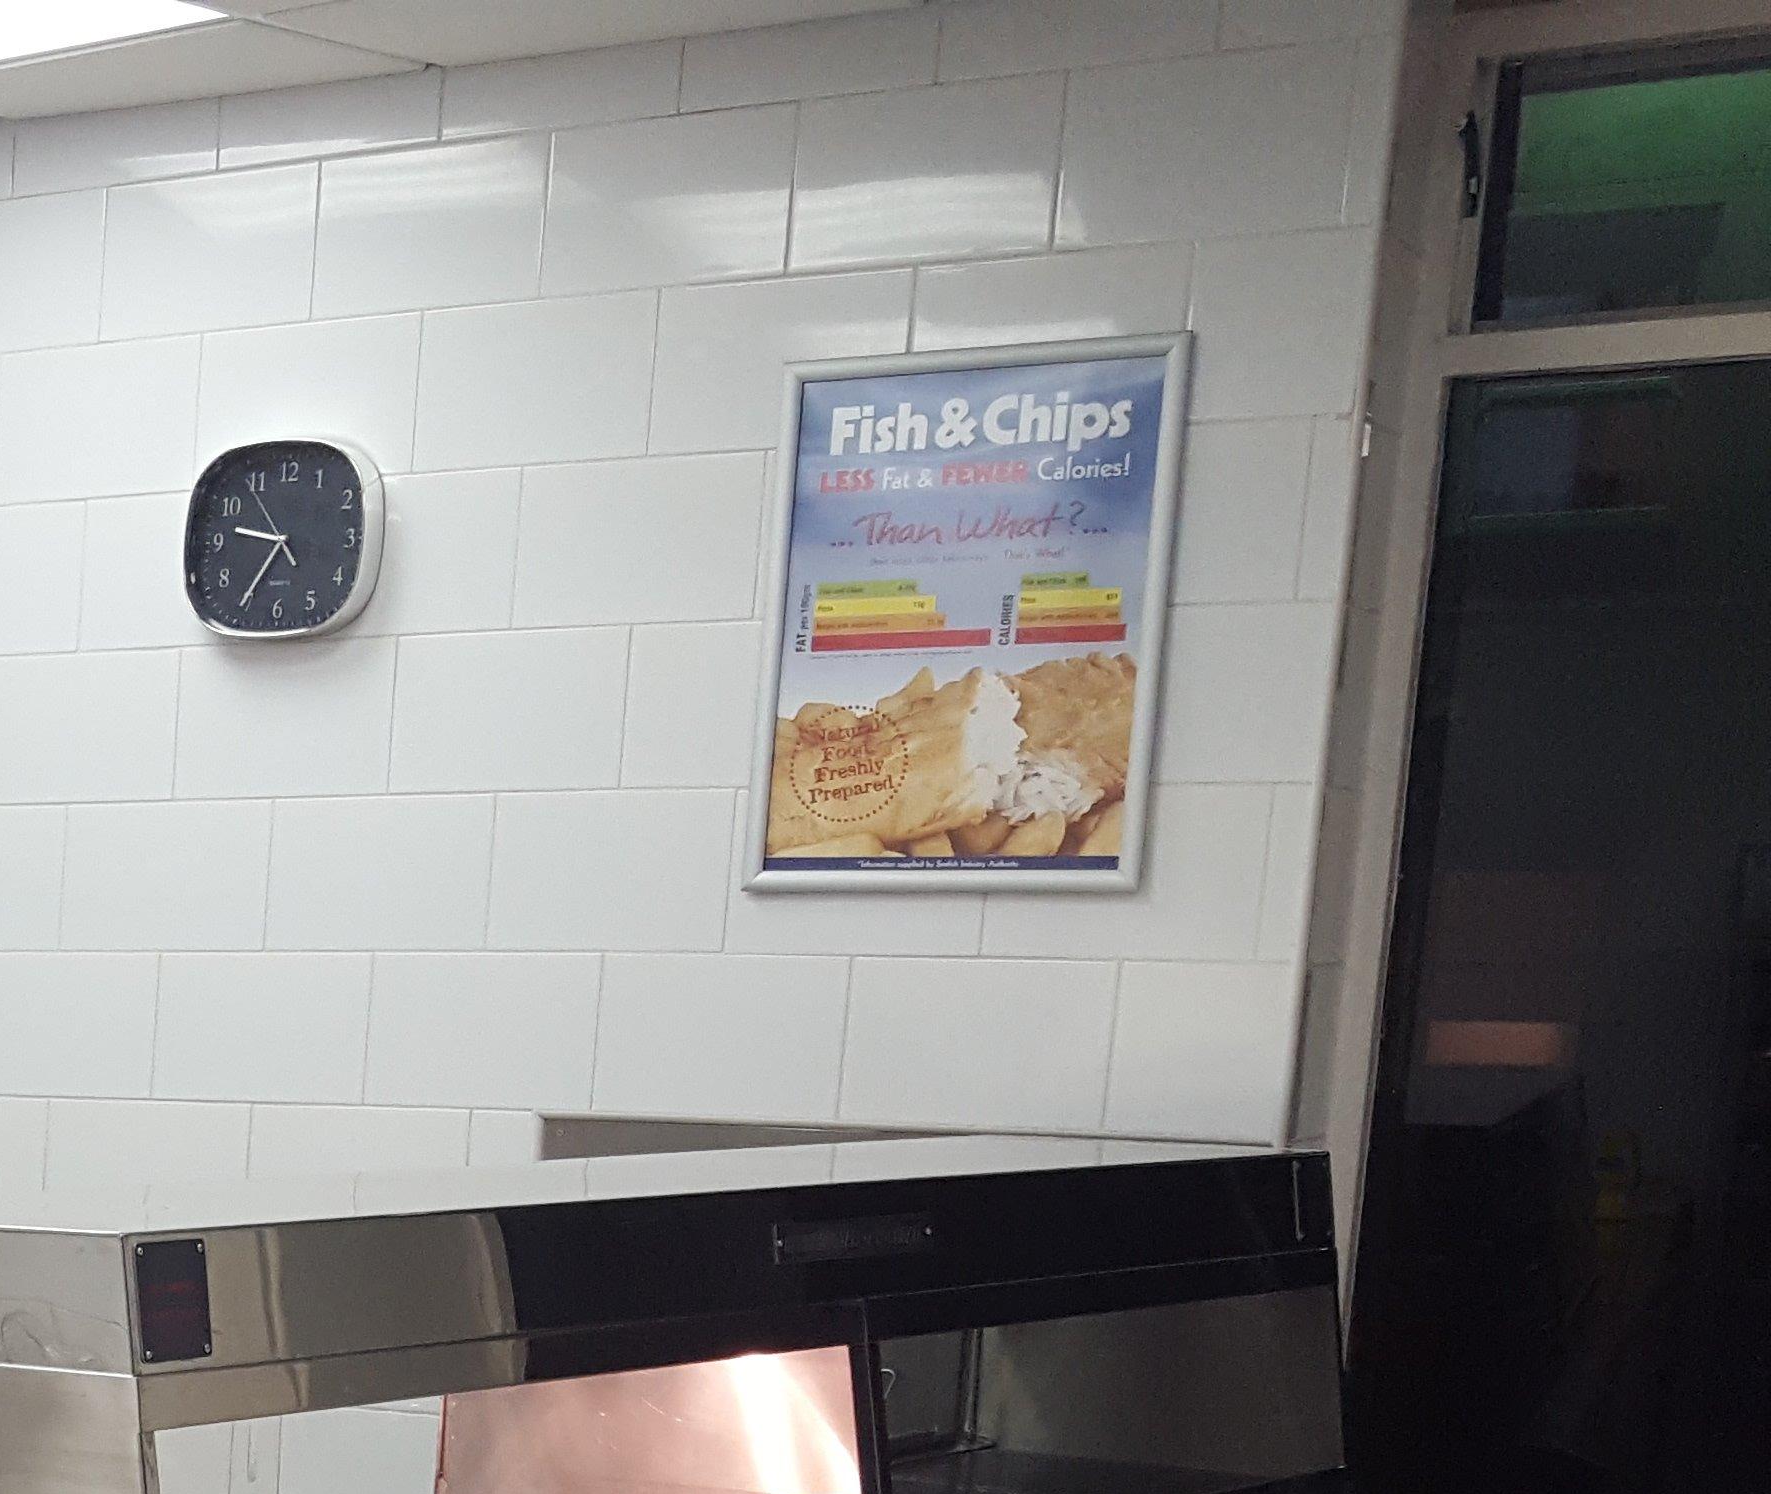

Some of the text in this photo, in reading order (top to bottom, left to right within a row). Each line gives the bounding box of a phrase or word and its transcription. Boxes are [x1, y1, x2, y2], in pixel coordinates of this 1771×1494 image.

[829, 391, 1133, 456] Fish & Chips
[280, 462, 299, 482] 12
[1037, 452, 1130, 481] Calories!
[315, 469, 324, 488] 1
[222, 497, 241, 517] 10
[341, 489, 353, 509] 2
[213, 533, 224, 552] 9
[343, 528, 355, 549] 3
[219, 568, 230, 588] 8
[332, 566, 343, 586] 4
[272, 599, 283, 619] 6
[305, 590, 316, 611] 5
[814, 759, 884, 783] Freshly
[808, 775, 894, 804] Prepared
